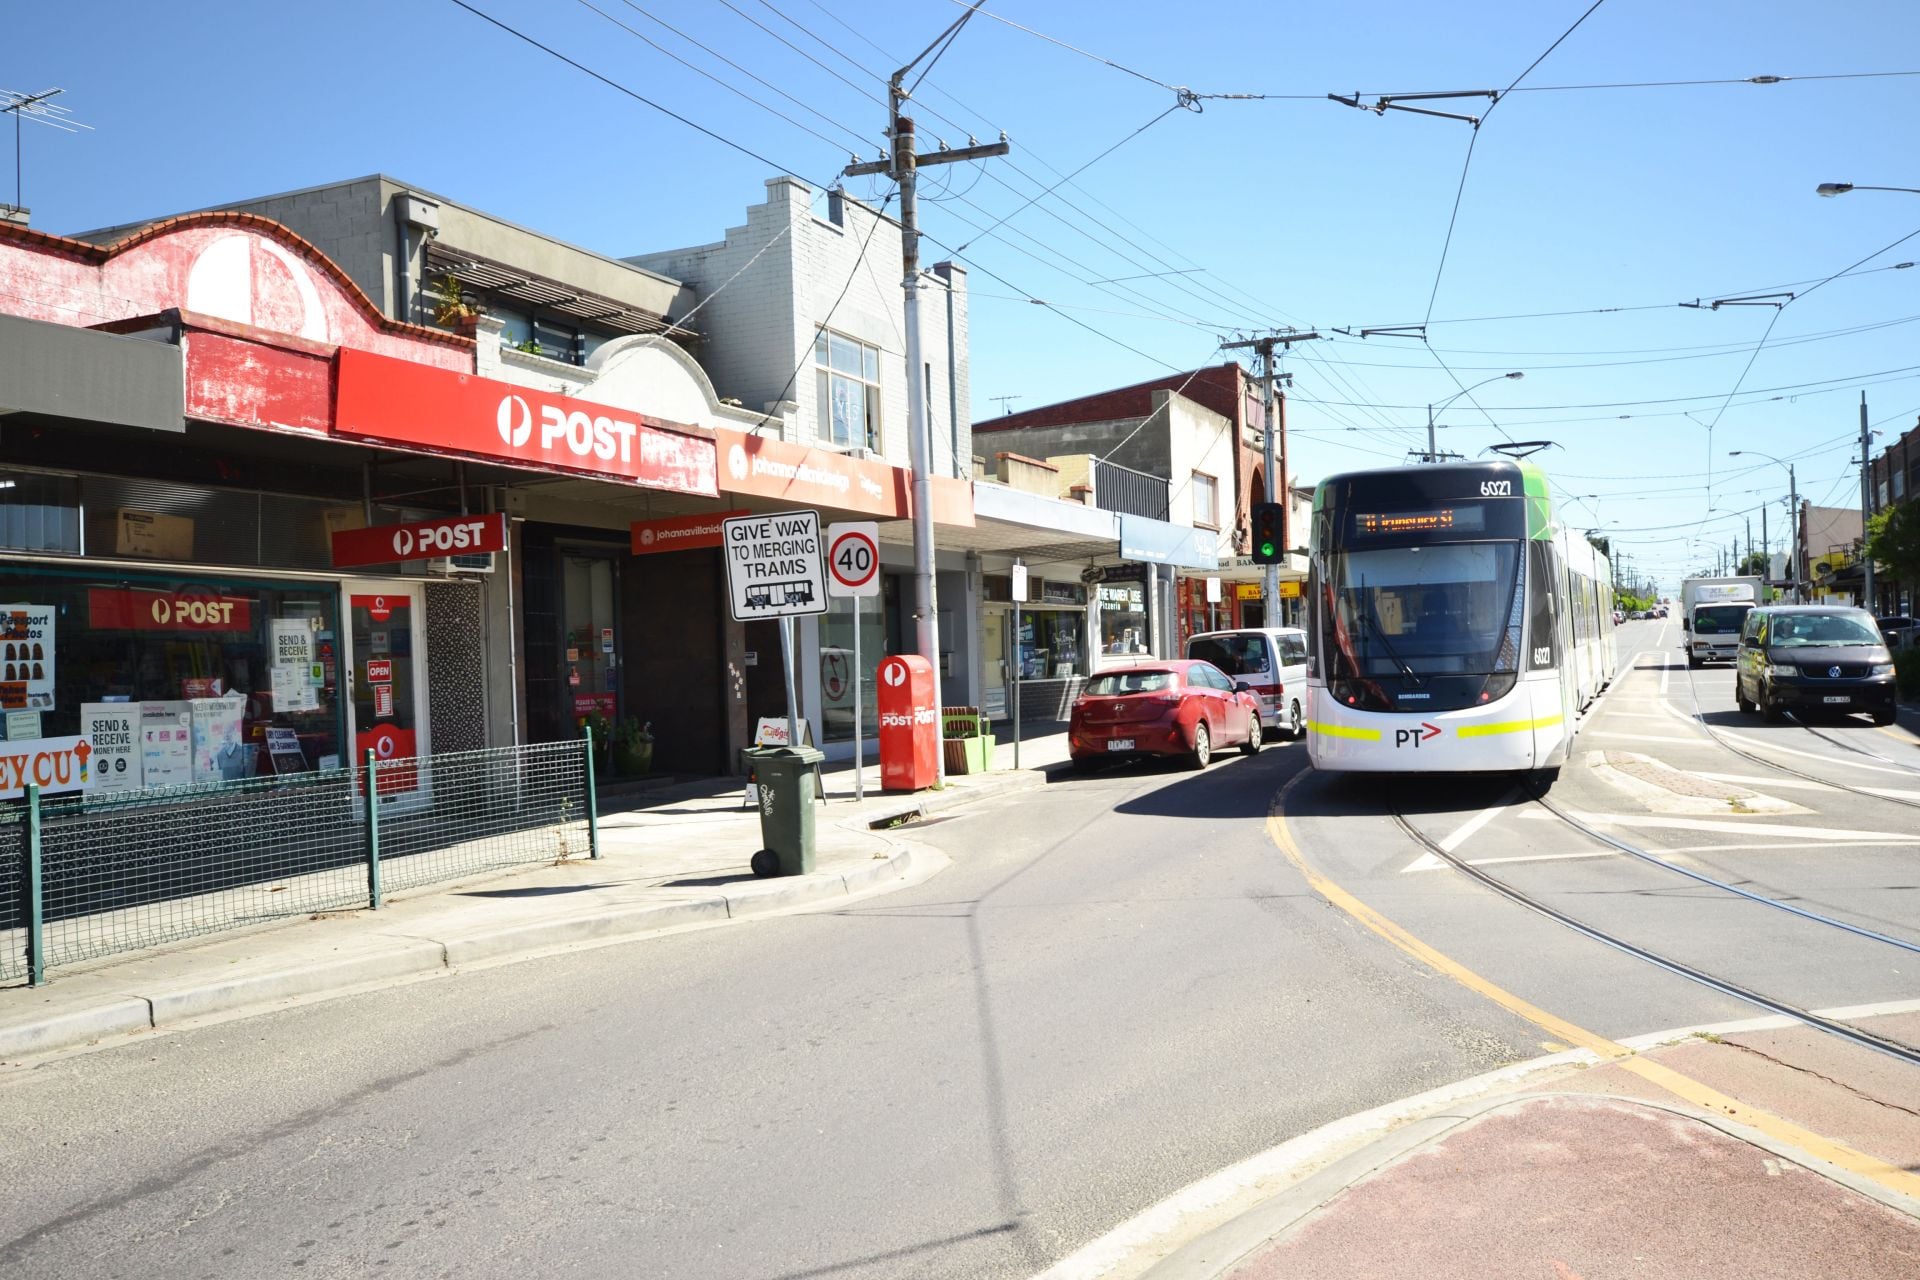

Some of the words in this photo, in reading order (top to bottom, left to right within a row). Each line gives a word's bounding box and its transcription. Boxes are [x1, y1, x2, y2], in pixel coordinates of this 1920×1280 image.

[541, 404, 637, 463] POST
[1480, 481, 1511, 496] 6027
[418, 522, 485, 552] POST
[731, 523, 771, 541] GIVE
[775, 519, 812, 537] WAY
[732, 545, 750, 560] TO
[753, 538, 816, 559] MERGING
[838, 547, 870, 571] 40
[743, 559, 807, 578] TRAMS
[175, 601, 234, 624] POST
[278, 635, 299, 646] SEND
[300, 634, 307, 645] &
[279, 646, 308, 656] RECEIVE
[1534, 647, 1550, 664] 6027
[369, 666, 390, 676] OPEN
[882, 715, 913, 727] POST
[914, 709, 935, 725] POST
[92, 720, 119, 733] SEND
[121, 719, 130, 731] &
[92, 732, 131, 746] RECEIVE
[93, 747, 115, 755] MONEY
